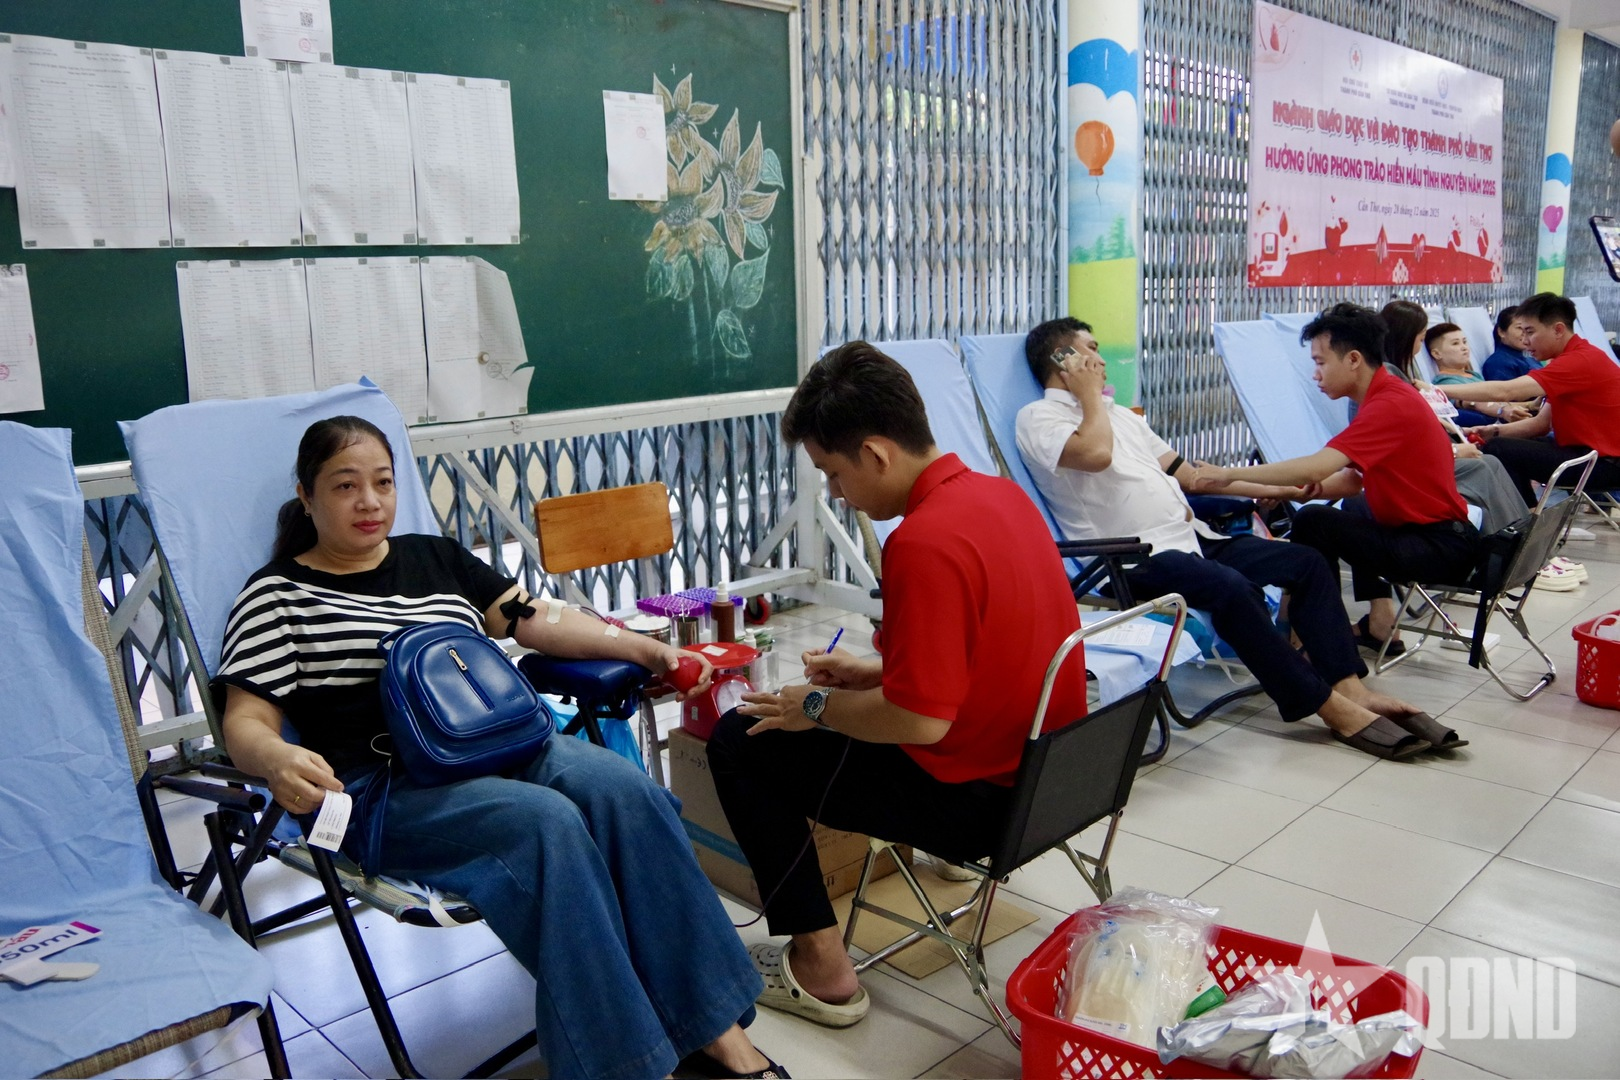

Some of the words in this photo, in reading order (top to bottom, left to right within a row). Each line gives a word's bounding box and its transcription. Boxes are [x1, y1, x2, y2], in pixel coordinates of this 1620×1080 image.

[1345, 115, 1364, 143] DỤC
[1367, 116, 1379, 141] VÀ
[1265, 142, 1305, 172] HƯỞNG
[1307, 146, 1329, 175] ỨNG
[1331, 155, 1362, 179] PHONG
[1364, 156, 1385, 182] TRÀO
[1406, 163, 1422, 186] MÁU
[1423, 165, 1439, 188] TÌNH
[0, 929, 79, 963] 50ml
